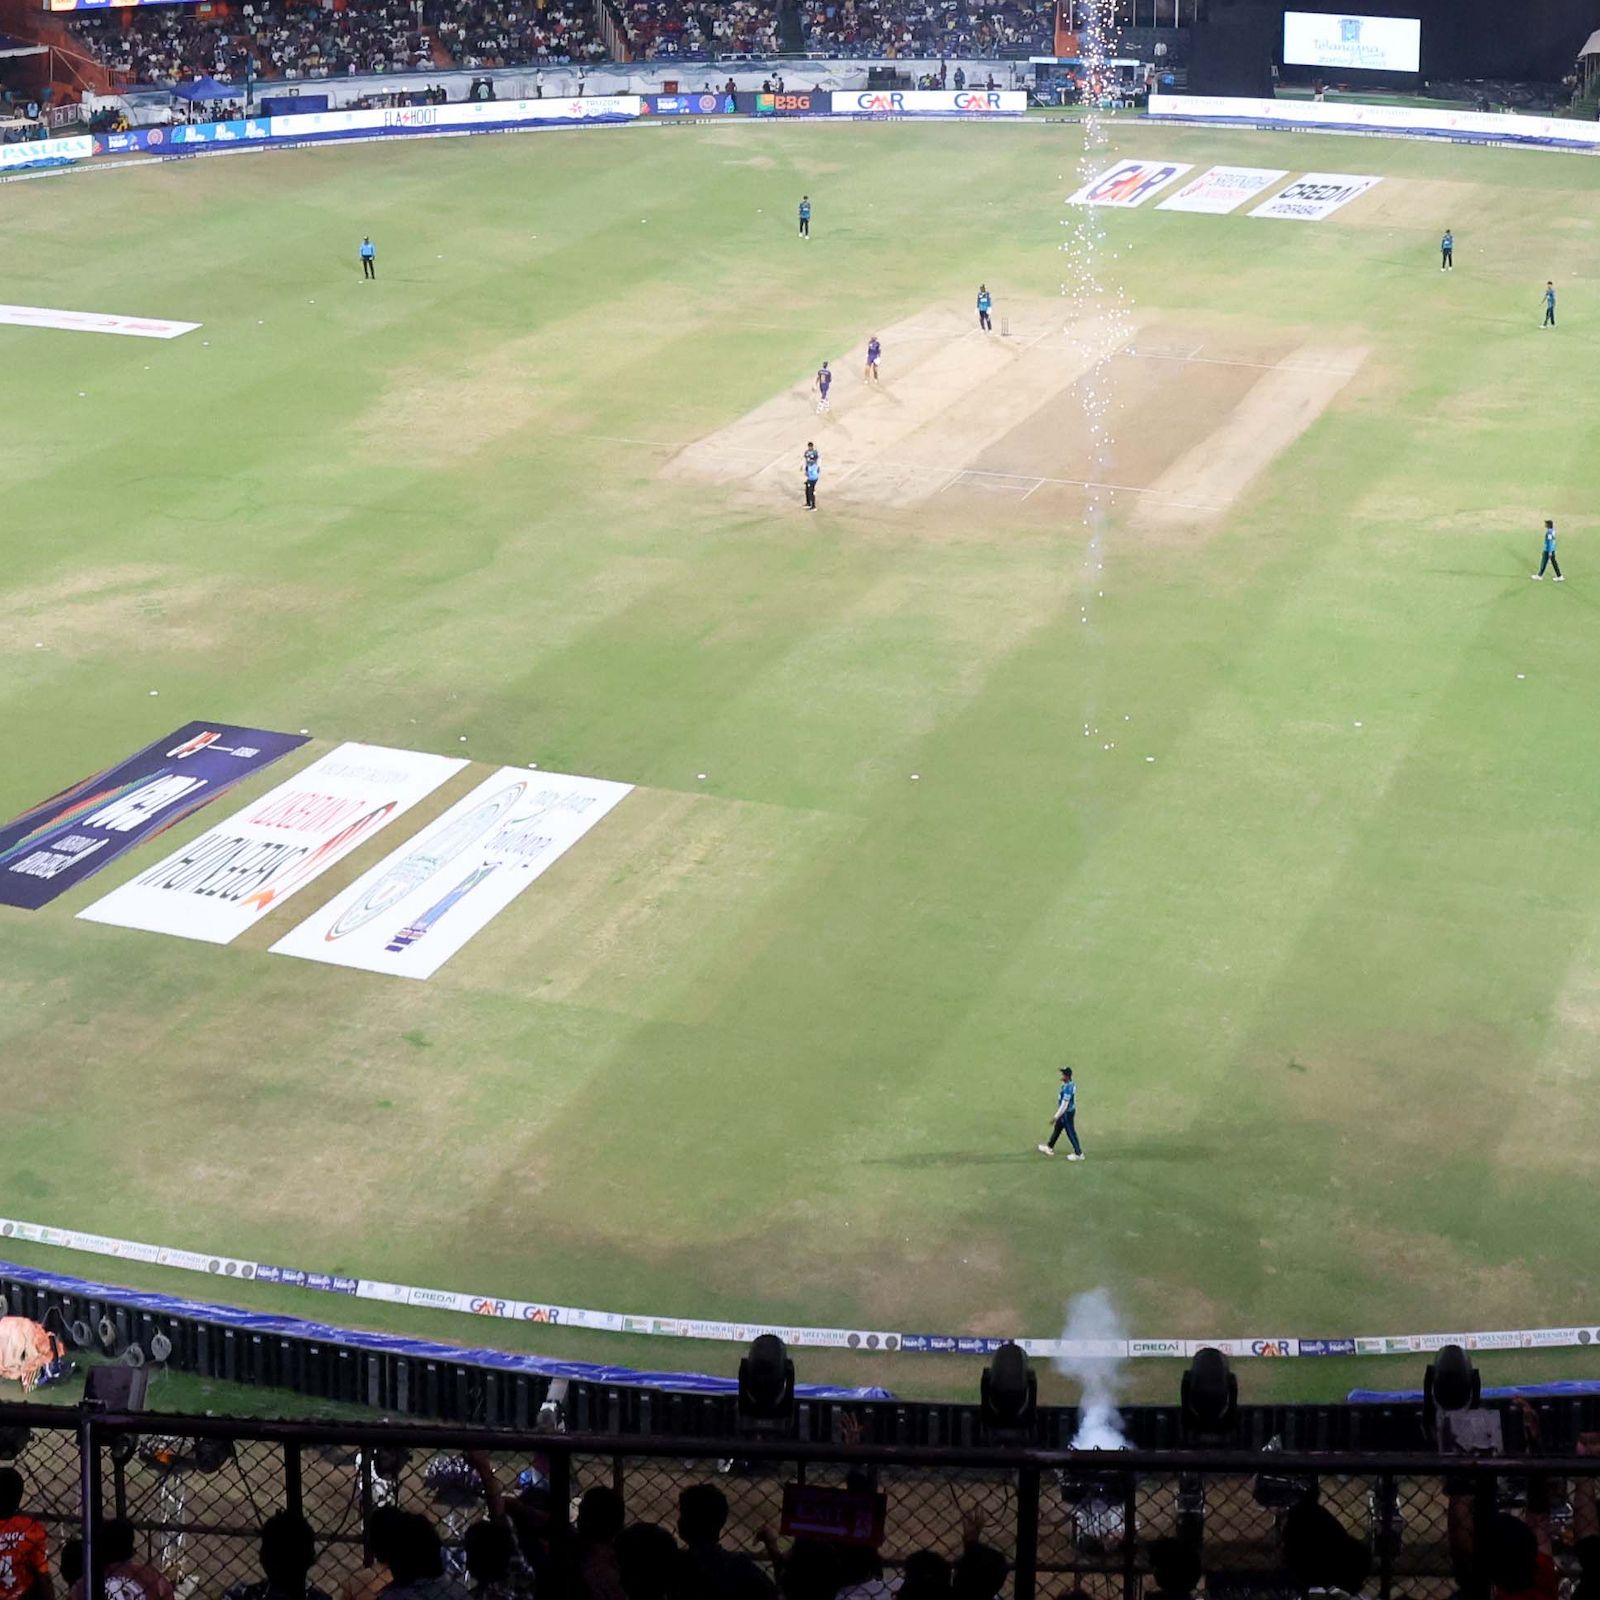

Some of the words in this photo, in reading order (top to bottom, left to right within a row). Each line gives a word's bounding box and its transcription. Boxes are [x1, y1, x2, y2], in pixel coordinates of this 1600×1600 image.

[775, 96, 810, 110] BBG
[2, 140, 86, 160] PASURA
[136, 832, 309, 902] SREENIDHI
